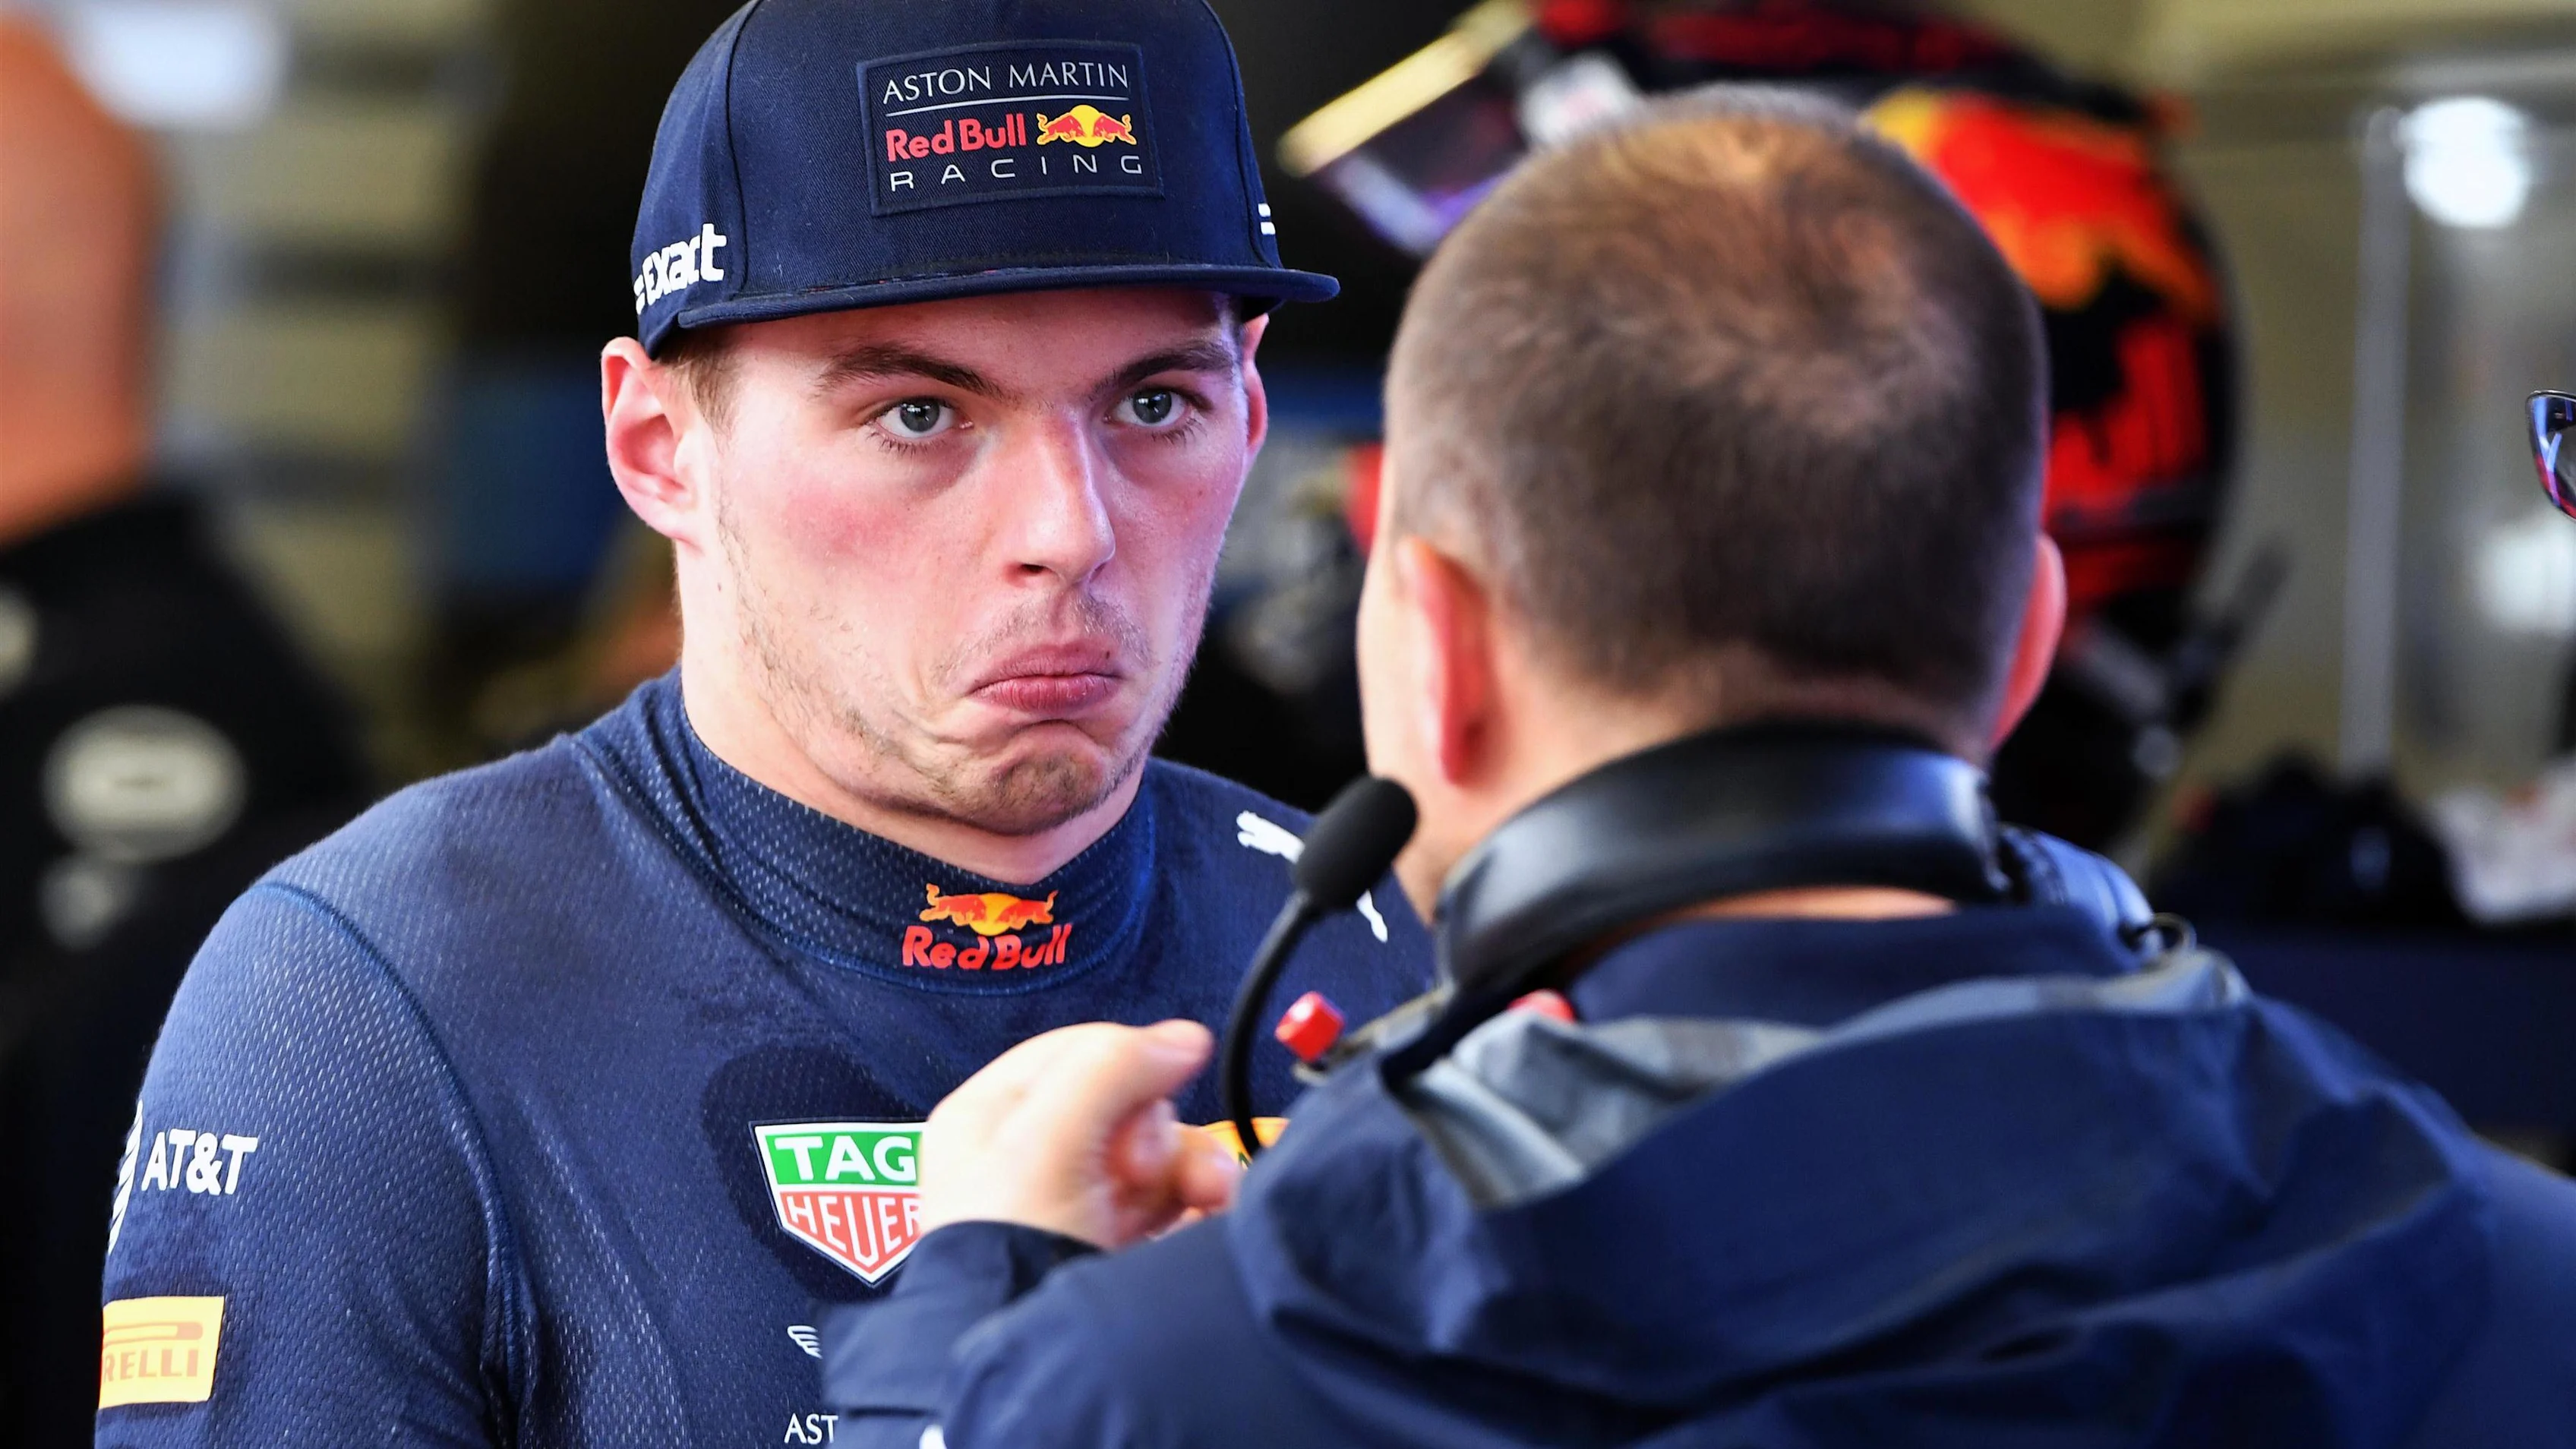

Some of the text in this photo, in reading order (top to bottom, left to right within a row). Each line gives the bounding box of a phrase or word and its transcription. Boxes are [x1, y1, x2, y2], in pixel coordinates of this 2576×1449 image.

[883, 62, 1129, 105] ASTON MARTIN
[886, 112, 1027, 162] Red Bull
[890, 154, 1142, 191] RACING
[901, 923, 1072, 971] Red Bull
[140, 1129, 259, 1195] AT&T
[774, 1135, 917, 1182] TAG
